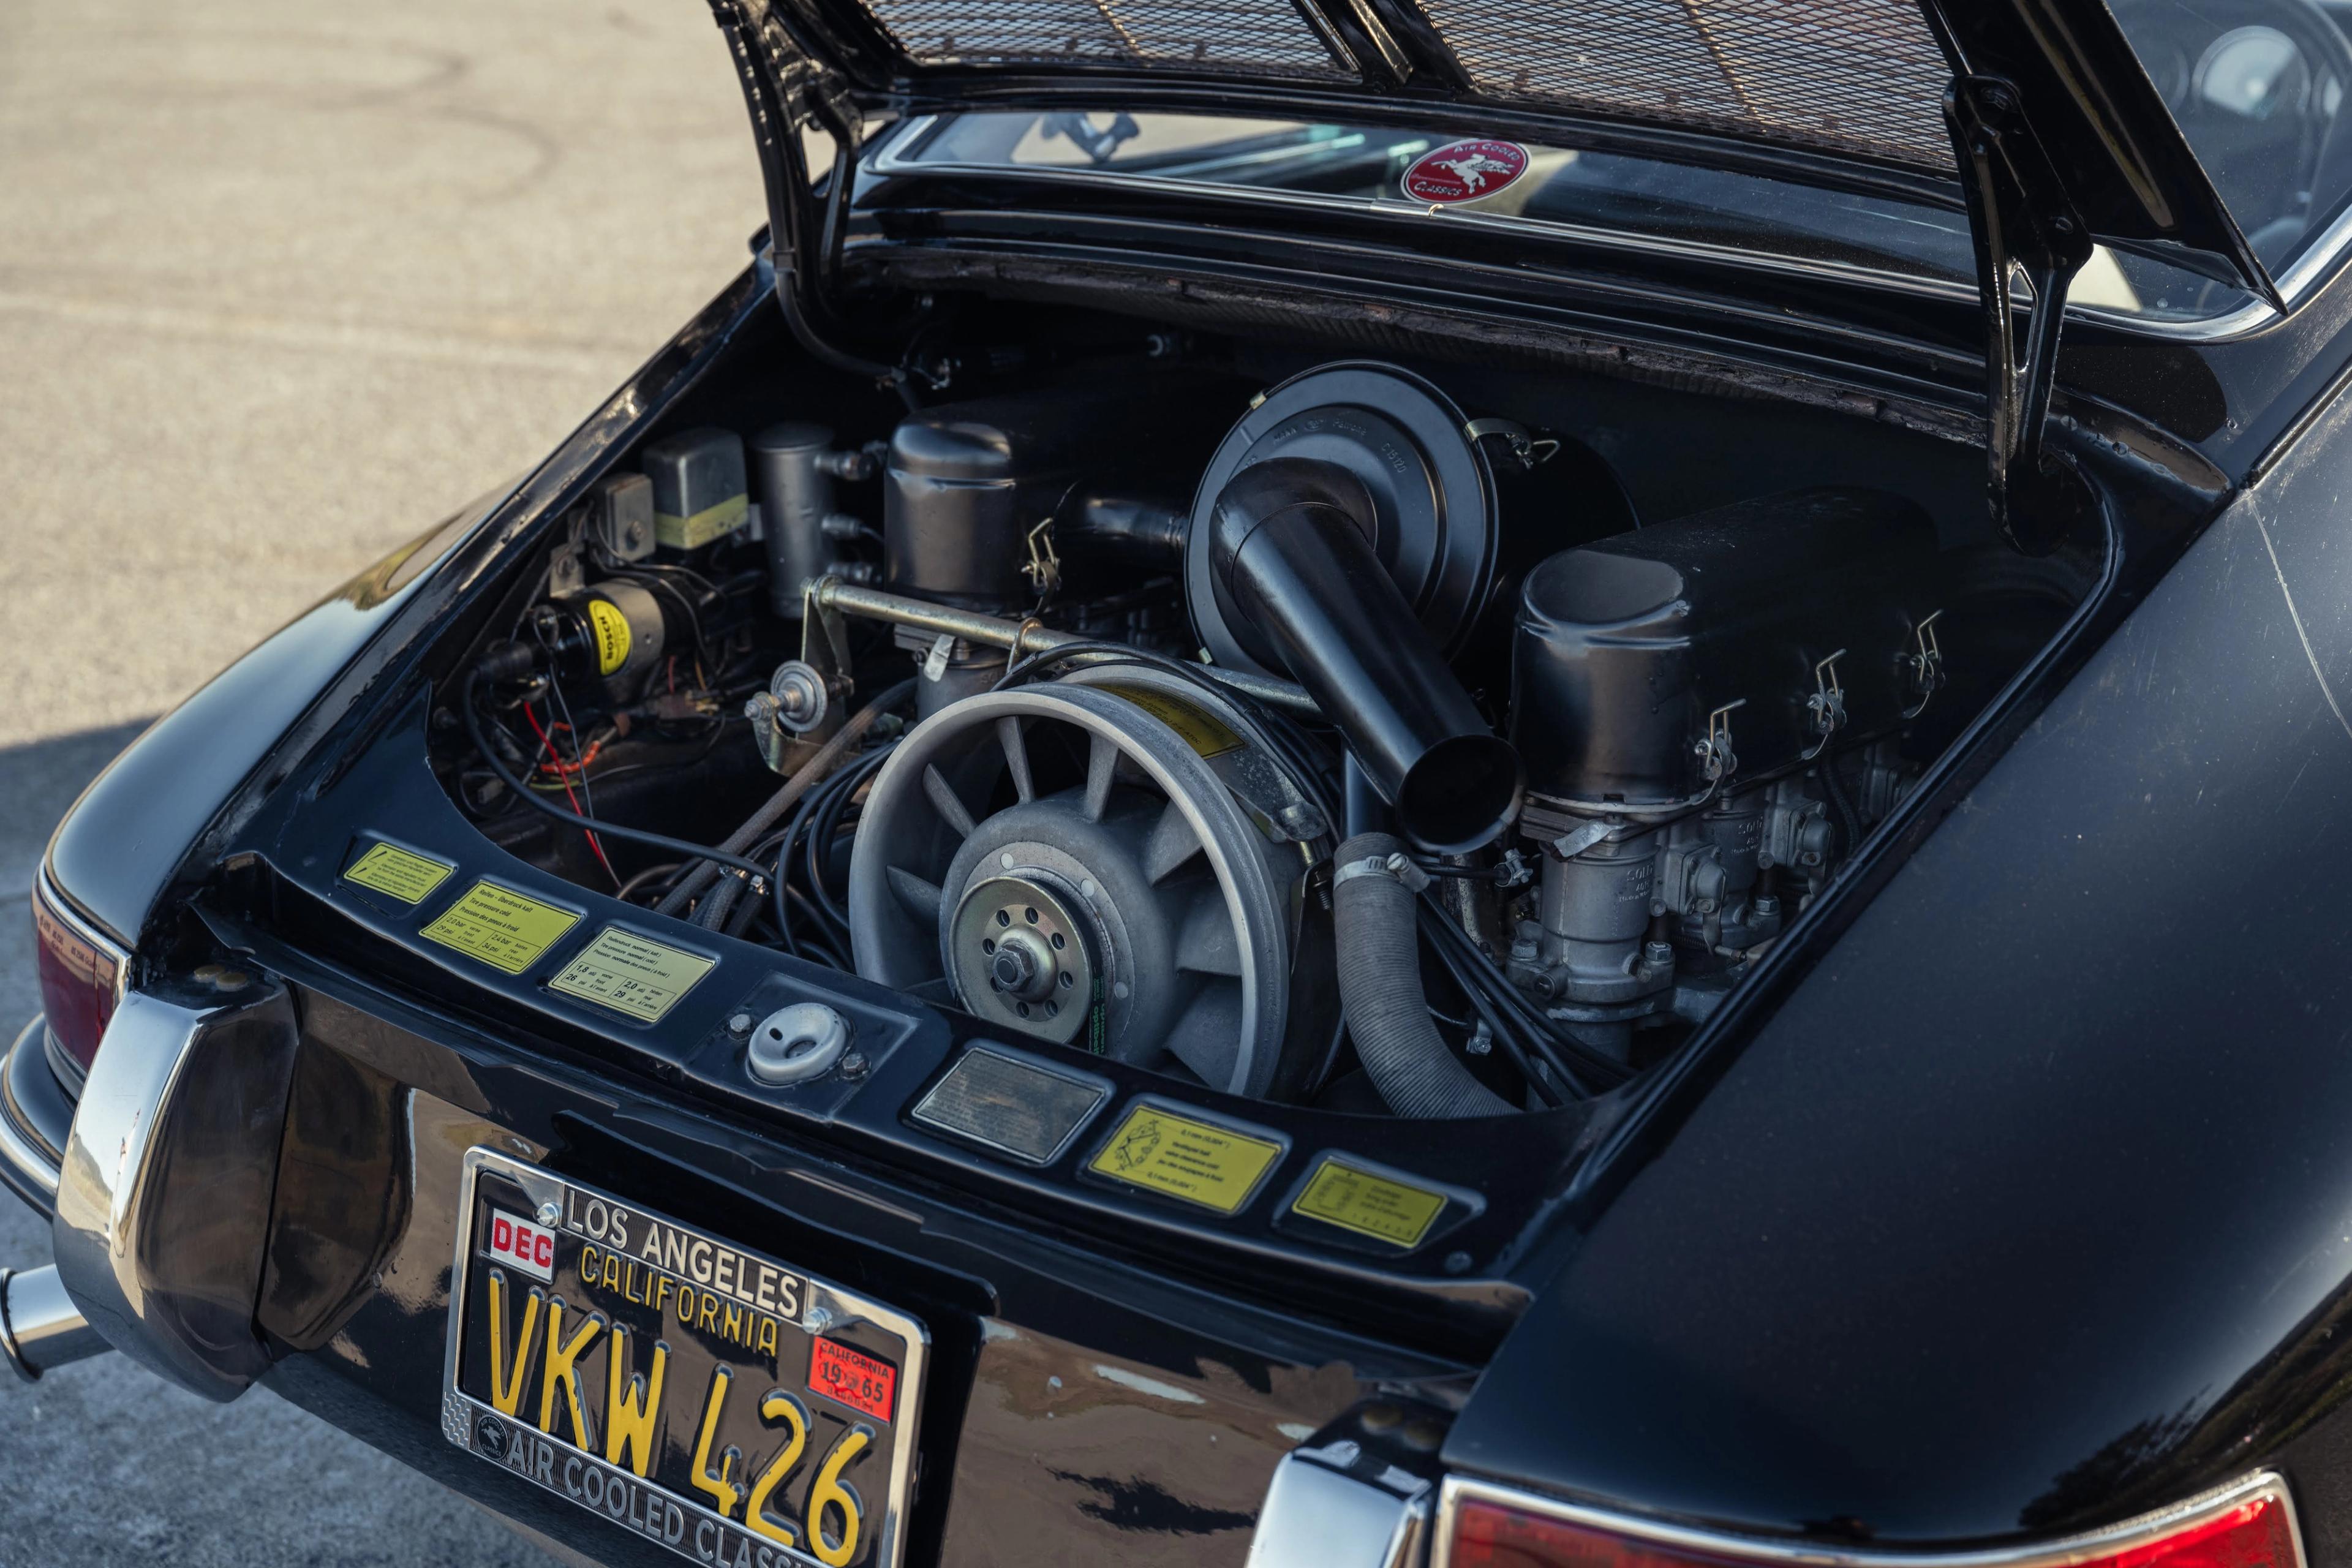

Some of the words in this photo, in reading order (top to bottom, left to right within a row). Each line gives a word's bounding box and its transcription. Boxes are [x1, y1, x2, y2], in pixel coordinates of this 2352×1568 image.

[599, 616, 614, 660] BOSCH
[492, 1216, 552, 1268] DEC
[567, 1190, 628, 1250] LOS
[641, 1223, 799, 1318] ANGELES
[581, 1245, 778, 1357] CALIFORNIA
[820, 1342, 889, 1379] CALIFORNIA
[821, 1361, 842, 1384] 19
[862, 1378, 883, 1403] 65
[489, 1272, 668, 1477] VKW
[691, 1367, 870, 1567] 426
[507, 1430, 554, 1485] AIR
[564, 1457, 684, 1545] COOLED
